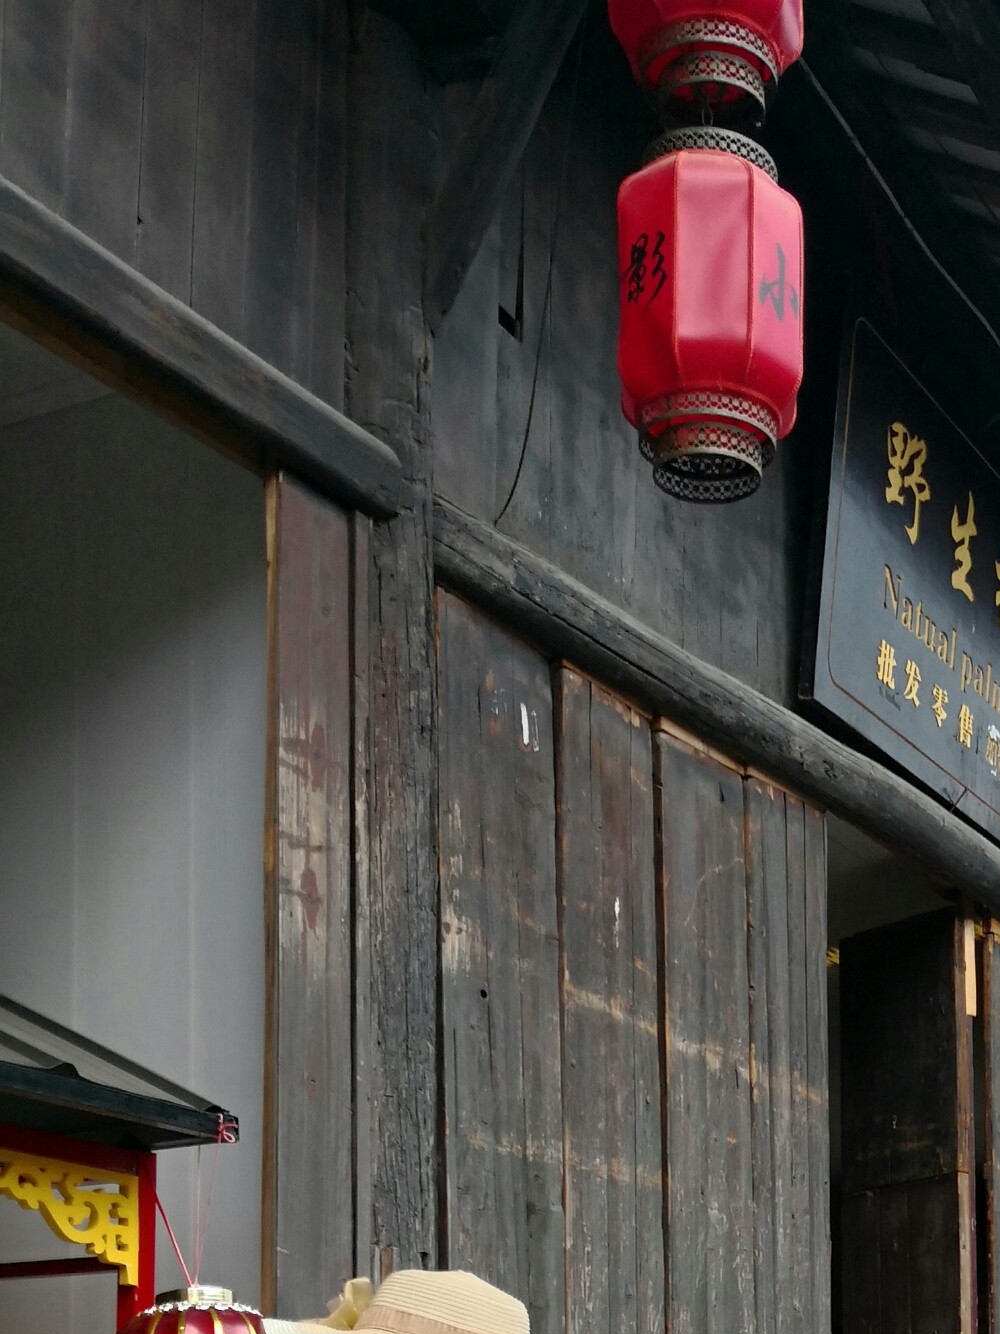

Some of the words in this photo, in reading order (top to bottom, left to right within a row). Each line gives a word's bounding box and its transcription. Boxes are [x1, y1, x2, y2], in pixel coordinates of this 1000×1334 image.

[622, 231, 667, 310] 影
[758, 242, 799, 322] 小
[883, 563, 958, 671] Natual
[876, 639, 974, 749] 批发零售
